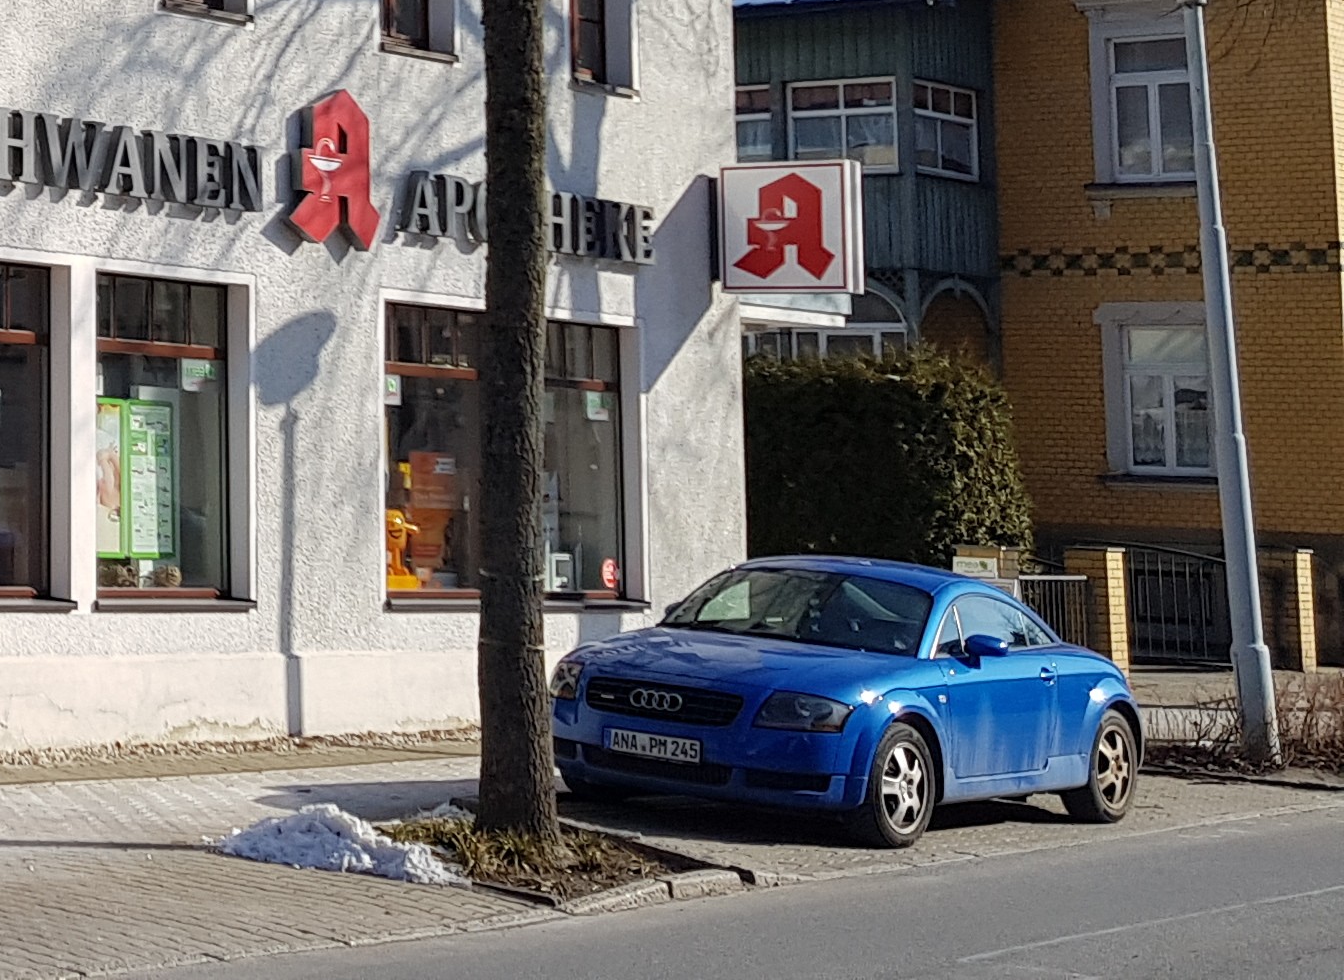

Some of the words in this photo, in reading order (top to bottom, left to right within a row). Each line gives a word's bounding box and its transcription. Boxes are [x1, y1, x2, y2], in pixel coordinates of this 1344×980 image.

[612, 731, 638, 751] ANA
[648, 736, 668, 755] PM
[671, 740, 698, 759] 245
